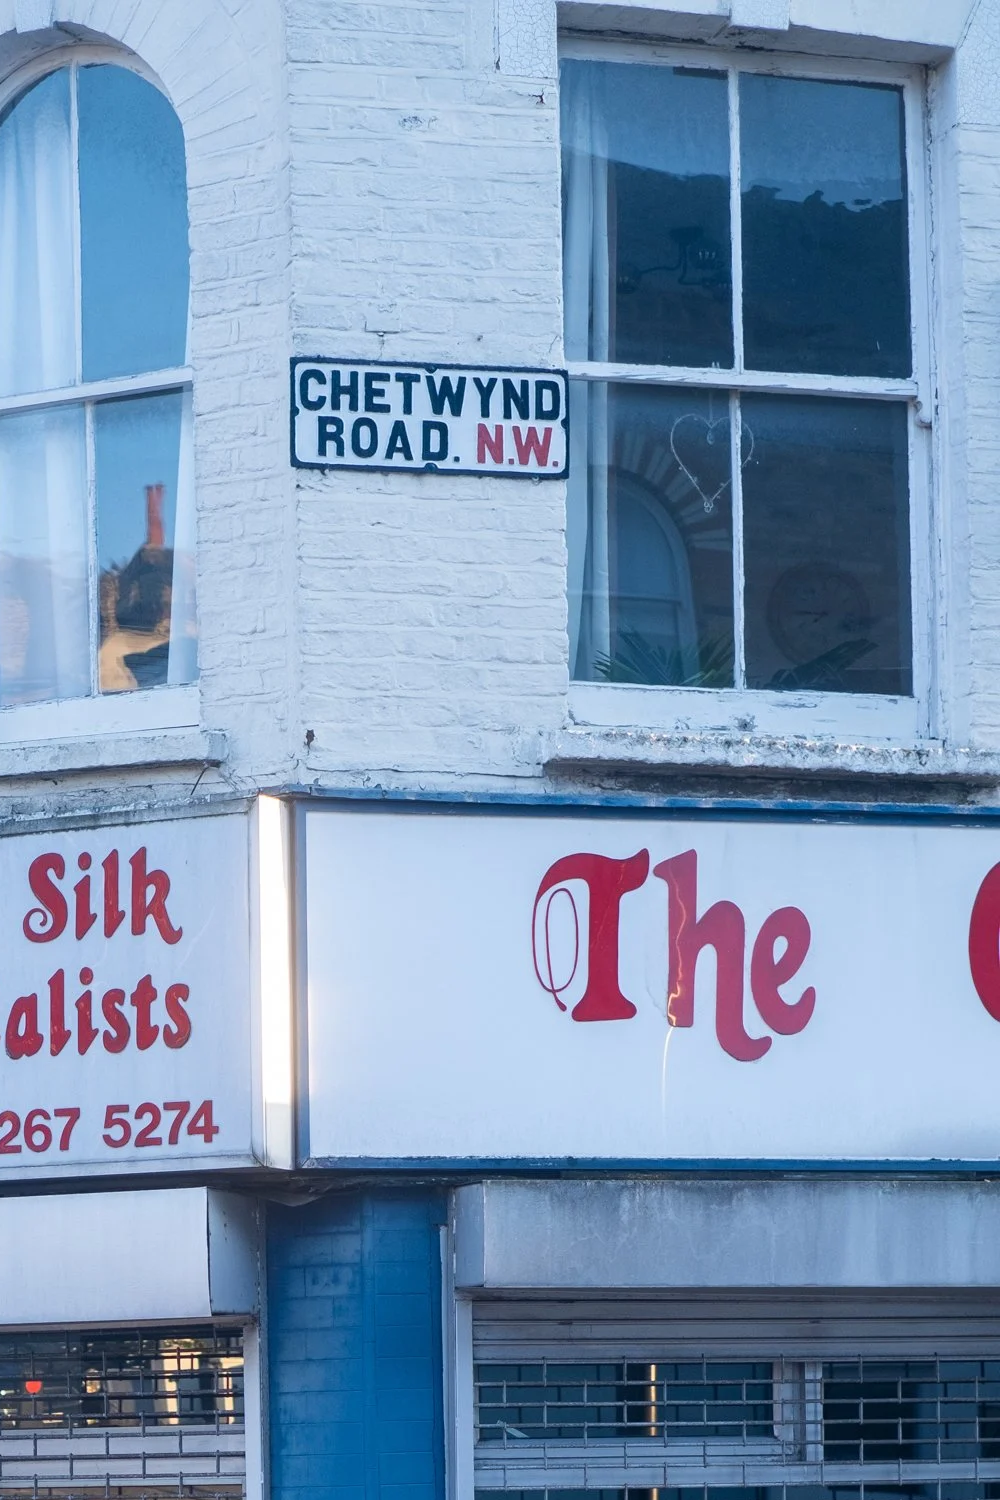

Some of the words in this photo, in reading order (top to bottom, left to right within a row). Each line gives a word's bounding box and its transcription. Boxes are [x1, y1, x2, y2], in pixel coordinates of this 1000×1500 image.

[299, 368, 561, 421] CHETWYND
[317, 415, 461, 463] ROAD.
[476, 422, 560, 468] N.W.
[21, 845, 184, 946] Silk
[531, 847, 817, 1063] The
[101, 1099, 220, 1149] 5274
